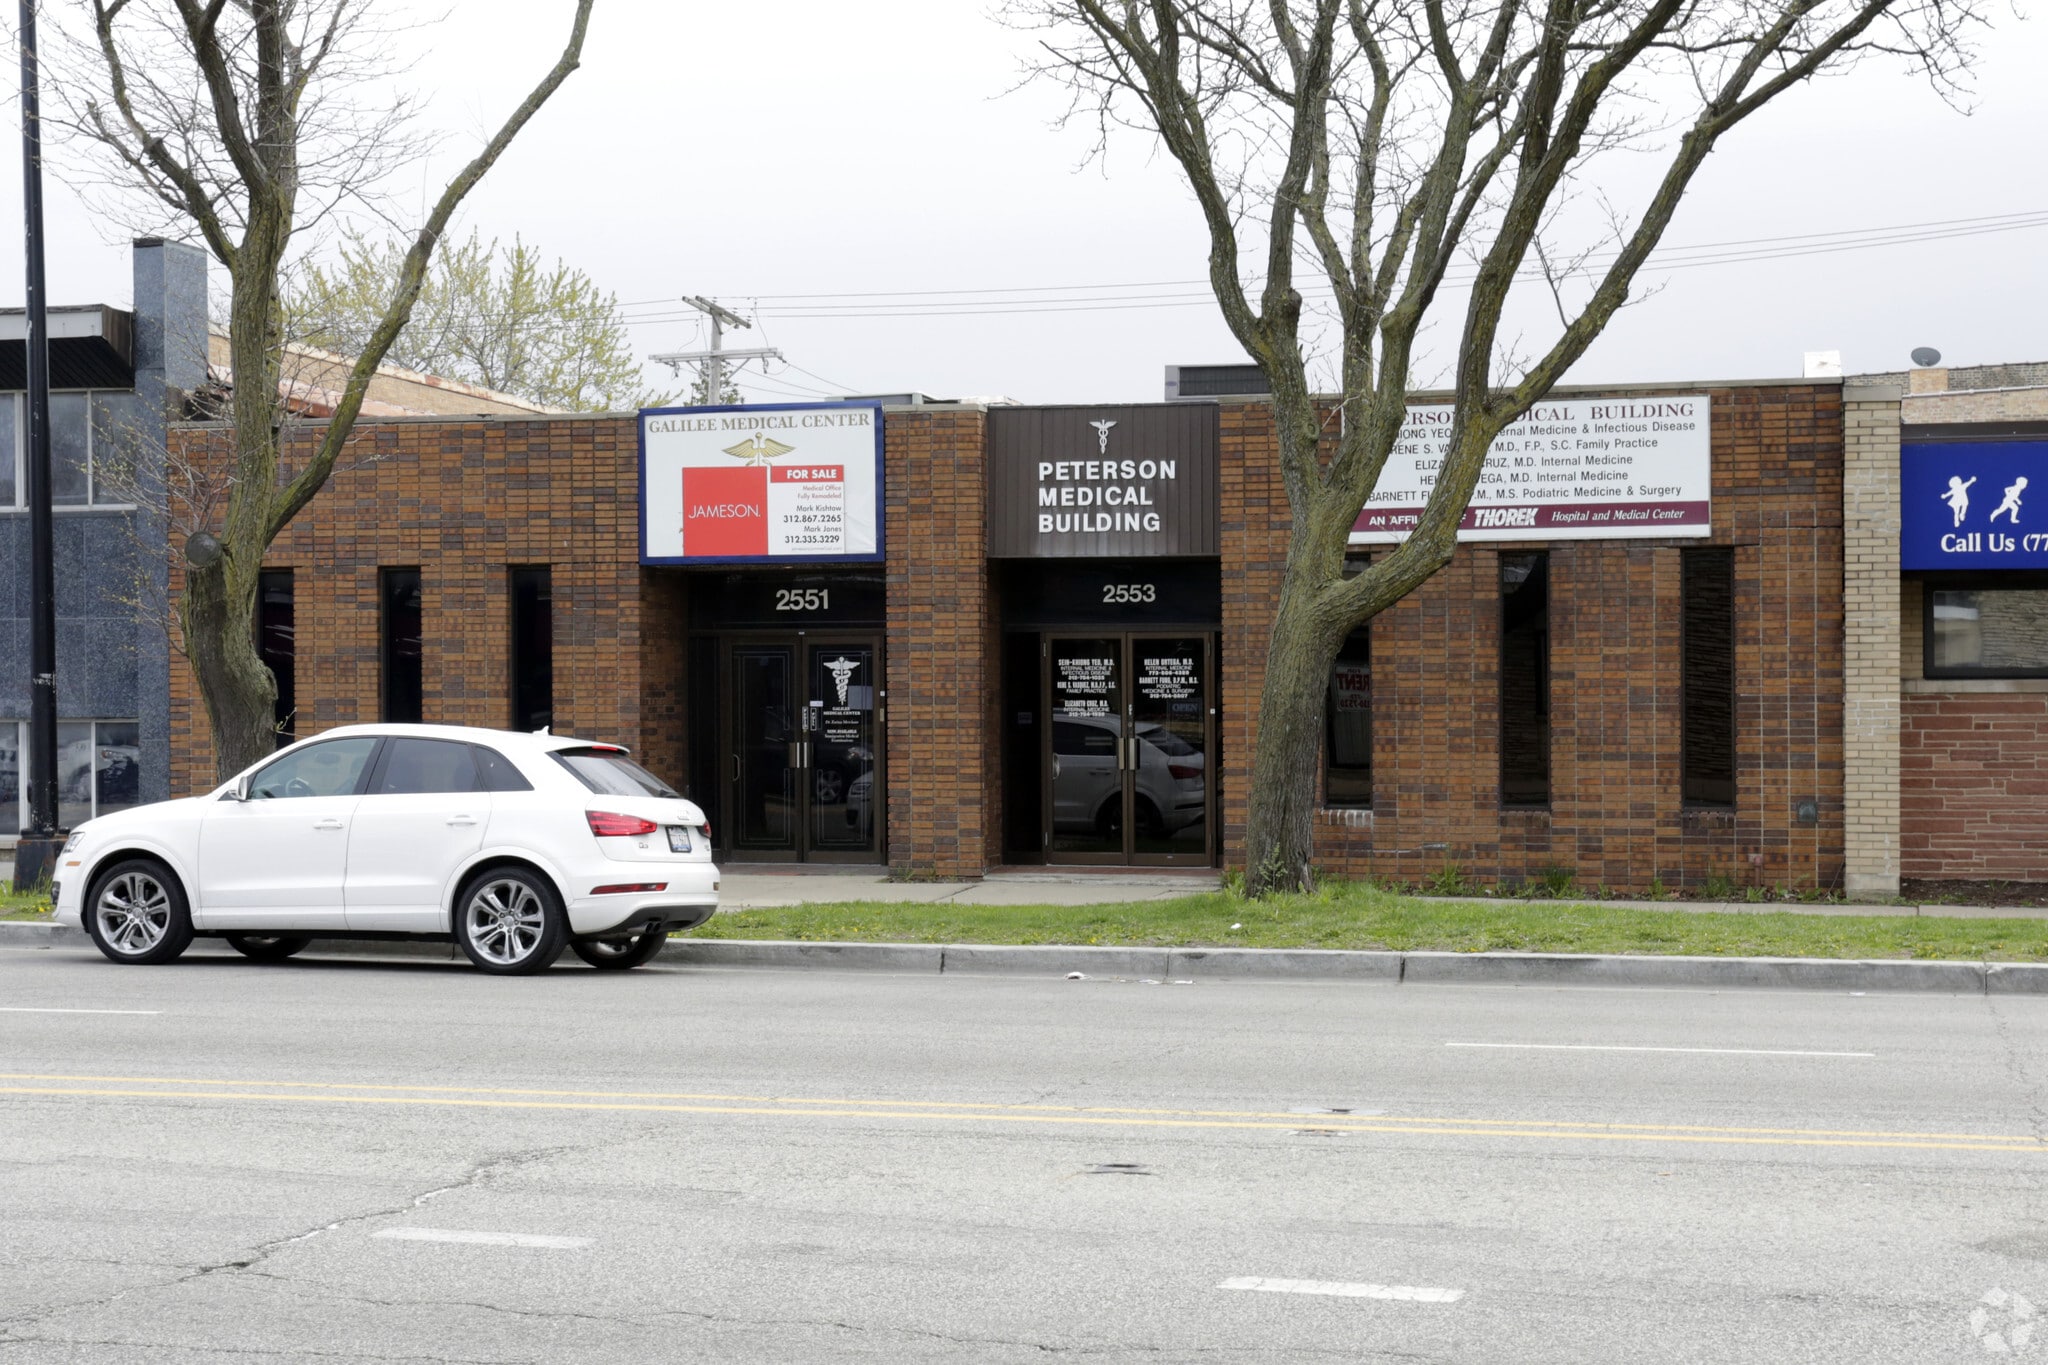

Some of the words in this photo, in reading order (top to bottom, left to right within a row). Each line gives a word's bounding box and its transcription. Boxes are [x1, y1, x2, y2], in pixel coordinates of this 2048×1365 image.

[1591, 403, 1694, 420] BUILDING
[649, 418, 717, 433] GALILEE
[721, 416, 798, 431] MEDICAL
[802, 413, 870, 428] CENTER
[1530, 424, 1577, 435] Medicine
[1582, 423, 1589, 434] &
[1594, 422, 1647, 433] Infectious
[1652, 421, 1695, 431] Disease
[1423, 444, 1434, 454] S.
[1551, 440, 1572, 450] S.C.
[1576, 439, 1610, 450] Family
[1614, 438, 1658, 448] Practice
[1483, 457, 1510, 468] RUZ,
[1514, 457, 1537, 467] M.D.
[1541, 456, 1581, 466] Internal
[1585, 455, 1633, 465] Medicine
[787, 469, 808, 479] FOR
[812, 469, 837, 479] SALE
[1039, 460, 1175, 481] PETERSON
[1510, 473, 1532, 482] M.D.
[1536, 472, 1576, 482] Internal
[1580, 471, 1628, 481] Medicine
[1039, 486, 1153, 506] MEDICAL
[1496, 488, 1518, 499] M.S.
[1523, 488, 1569, 498] Podiatric
[1574, 487, 1622, 497] Medicine
[1627, 486, 1634, 495] &
[1639, 485, 1682, 497] Surgery
[783, 514, 842, 523] 312.867.2265
[1039, 513, 1160, 533] BUILDING
[1368, 516, 1386, 526] AN
[1474, 507, 1539, 527] THOREK
[1551, 510, 1589, 523] Hospital
[1592, 511, 1609, 521] and
[1613, 509, 1649, 520] Medical
[1652, 508, 1685, 519] Center
[784, 535, 840, 543] 312.335.3229
[1940, 532, 1982, 552] Call
[1988, 533, 2016, 552] Us
[776, 589, 829, 610] 2551
[1103, 584, 1156, 603] 2553
